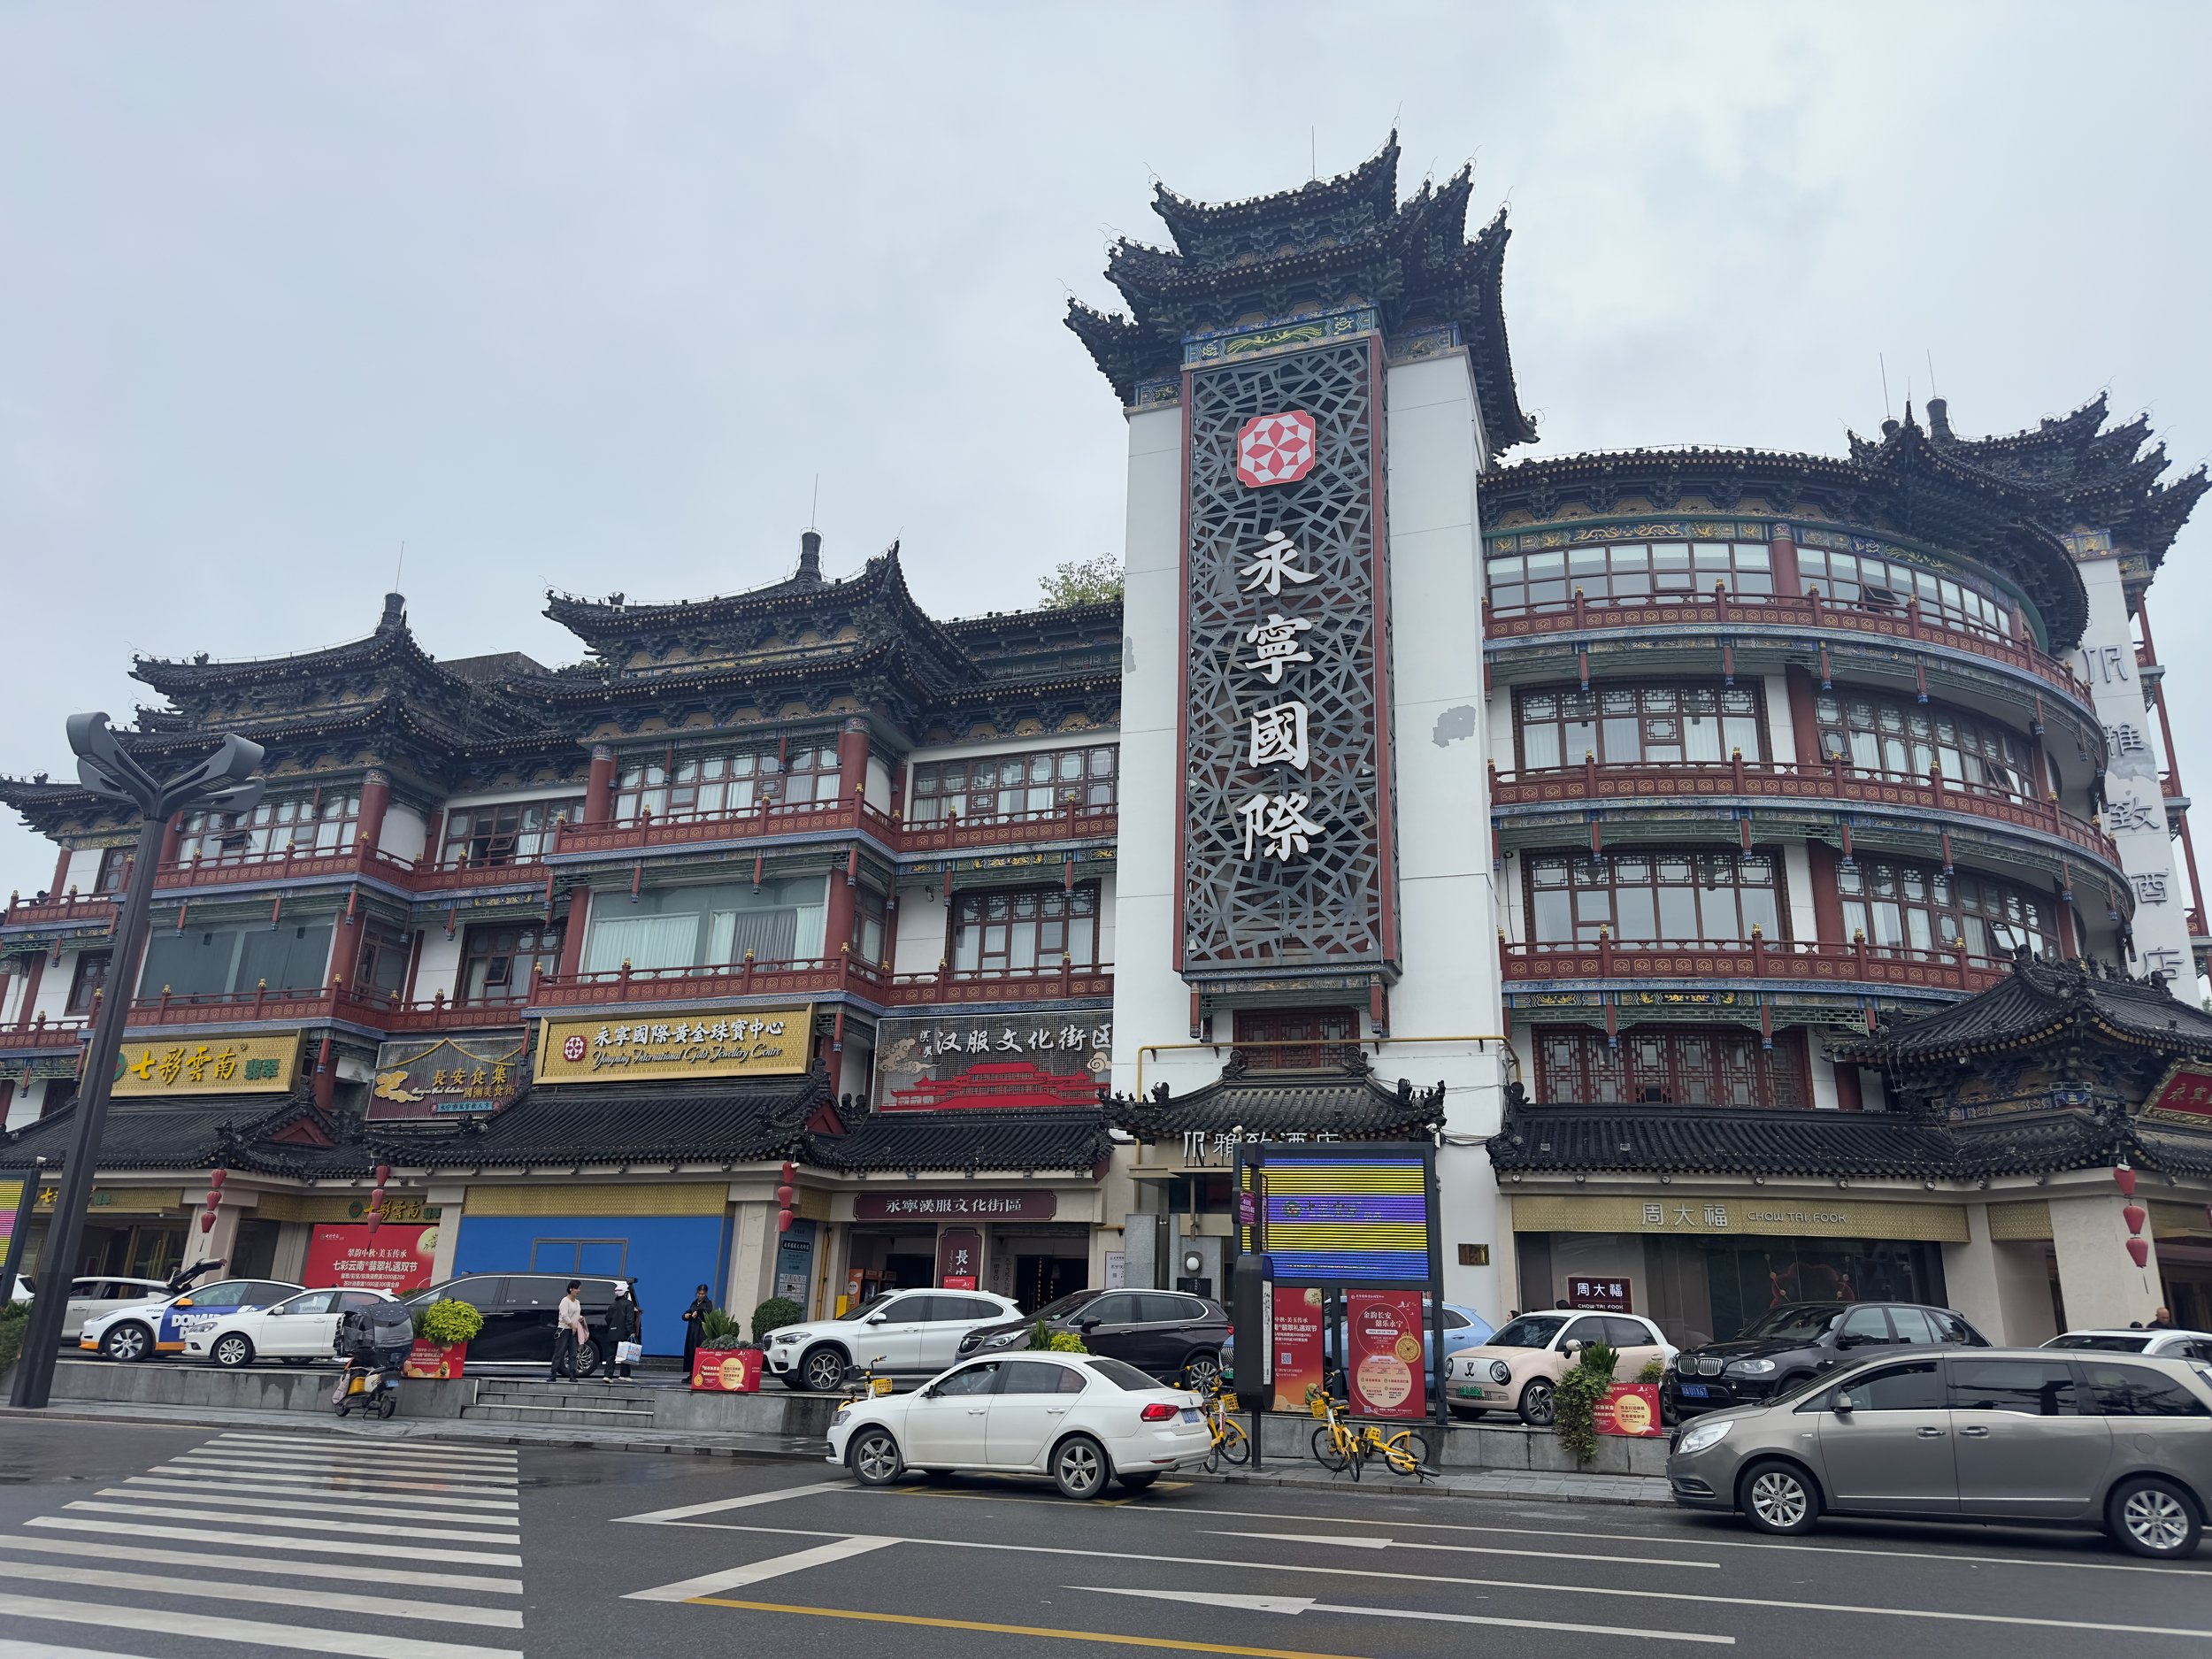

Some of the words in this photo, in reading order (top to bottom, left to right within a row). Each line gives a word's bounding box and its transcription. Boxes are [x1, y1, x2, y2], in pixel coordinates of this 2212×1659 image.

[1238, 530, 1325, 861] 永寧國際
[1641, 1202, 1728, 1227] 周大福
[1747, 1211, 1784, 1222] CHOW
[1787, 1212, 1806, 1222] TAI
[1813, 1213, 1847, 1224] FOOK
[1577, 1283, 1624, 1297] 周大福
